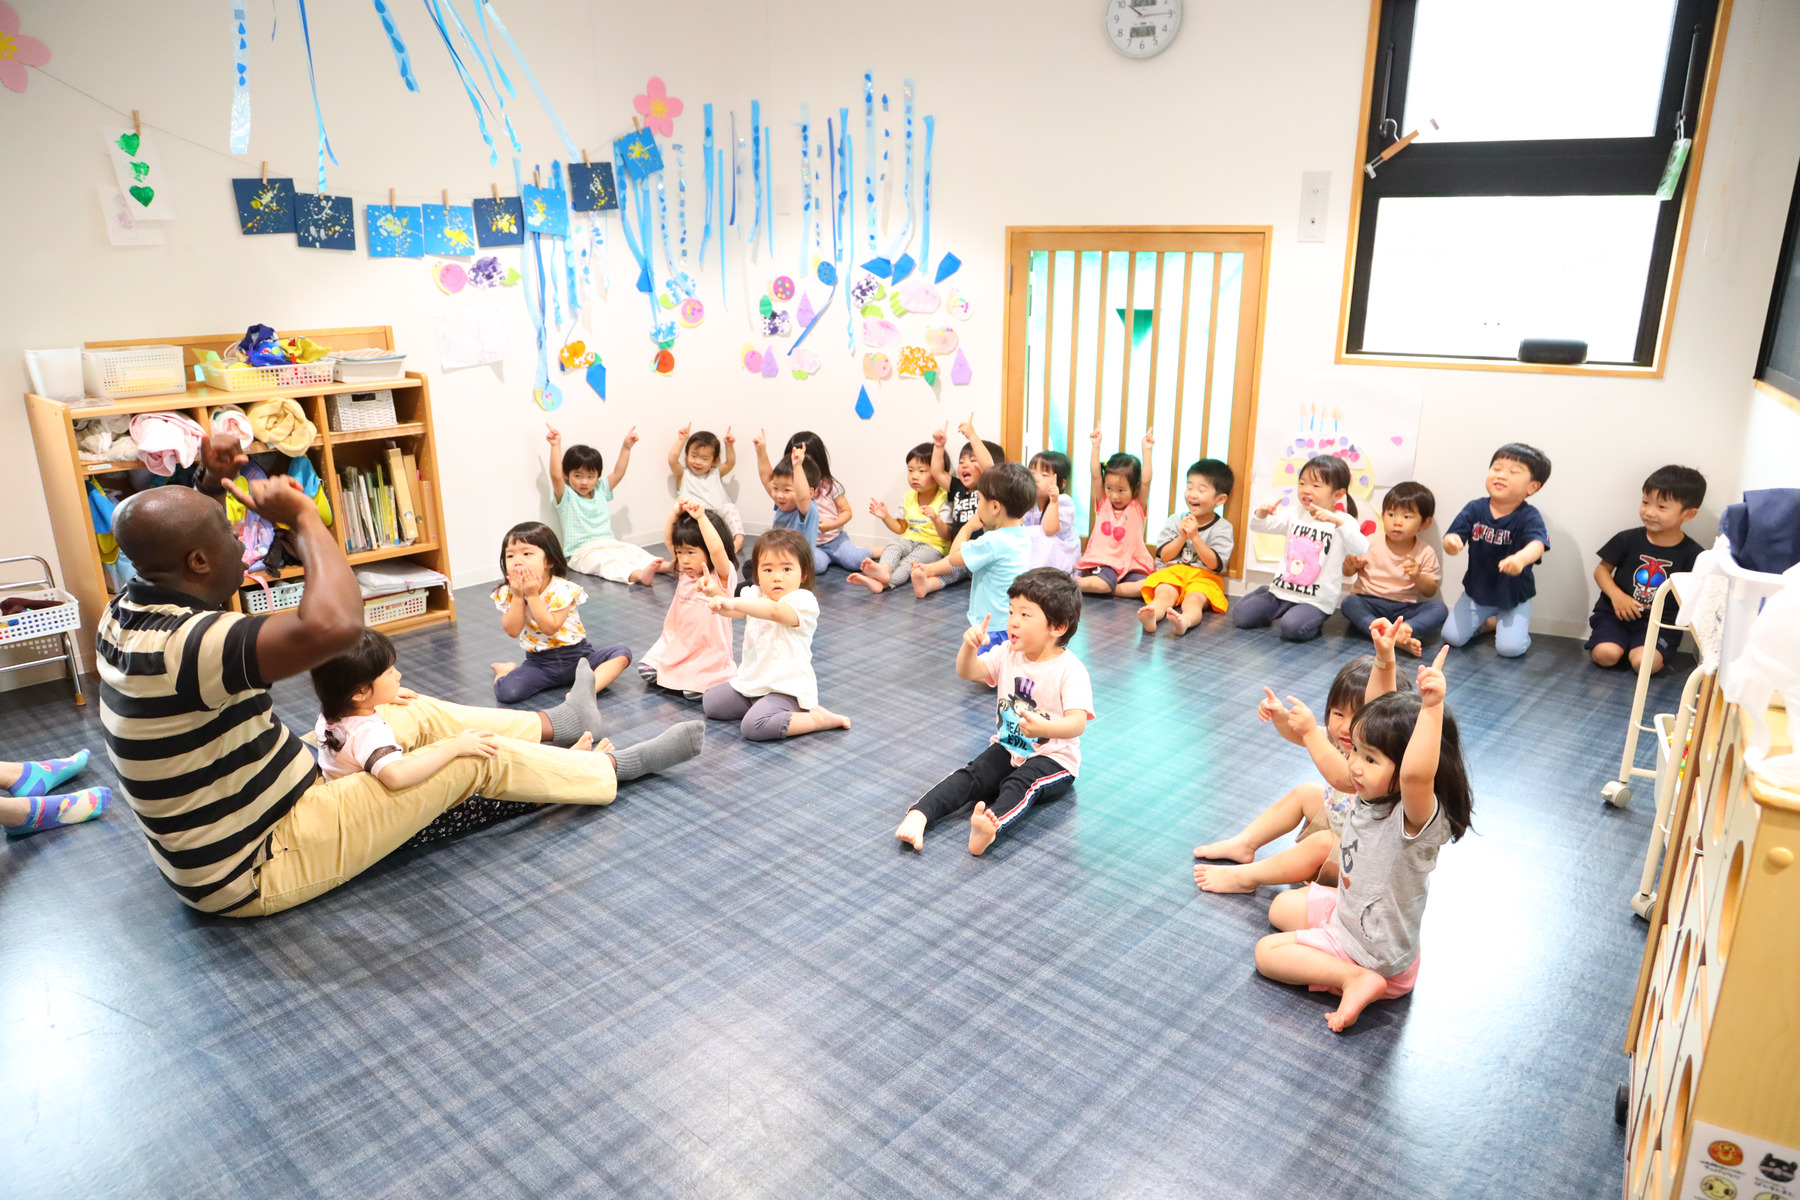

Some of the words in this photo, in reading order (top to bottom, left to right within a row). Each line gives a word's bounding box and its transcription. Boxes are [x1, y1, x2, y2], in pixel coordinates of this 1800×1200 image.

[1113, 14, 1120, 24] 9
[1167, 9, 1174, 19] 3
[1117, 28, 1124, 38] 8
[1161, 23, 1168, 33] 4
[1126, 38, 1133, 47] 7
[1139, 40, 1146, 50] 6
[1152, 35, 1159, 46] 5
[1007, 733, 1028, 751] EVIL
